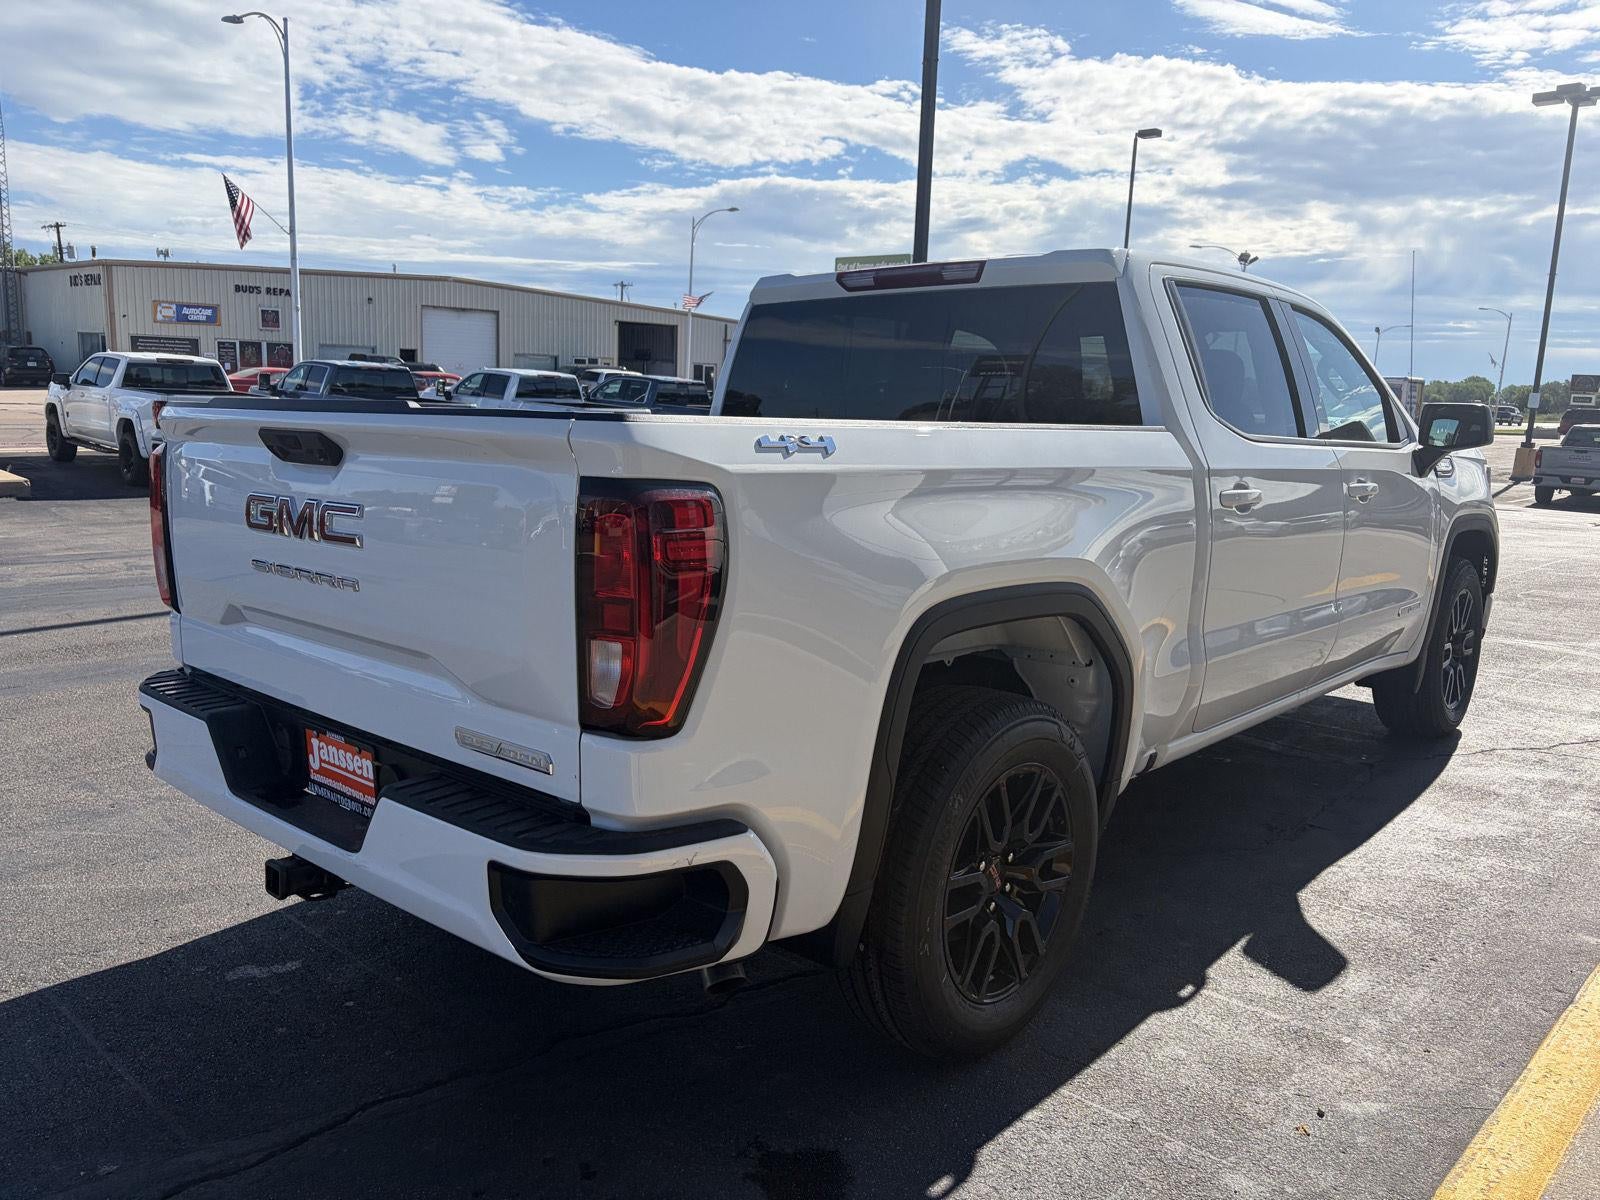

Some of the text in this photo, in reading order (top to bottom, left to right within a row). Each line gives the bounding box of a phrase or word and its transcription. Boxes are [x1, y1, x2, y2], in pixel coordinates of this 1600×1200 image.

[234, 284, 293, 297] BUD'S REPA
[245, 492, 364, 549] GMC
[251, 558, 361, 592] SIERRA
